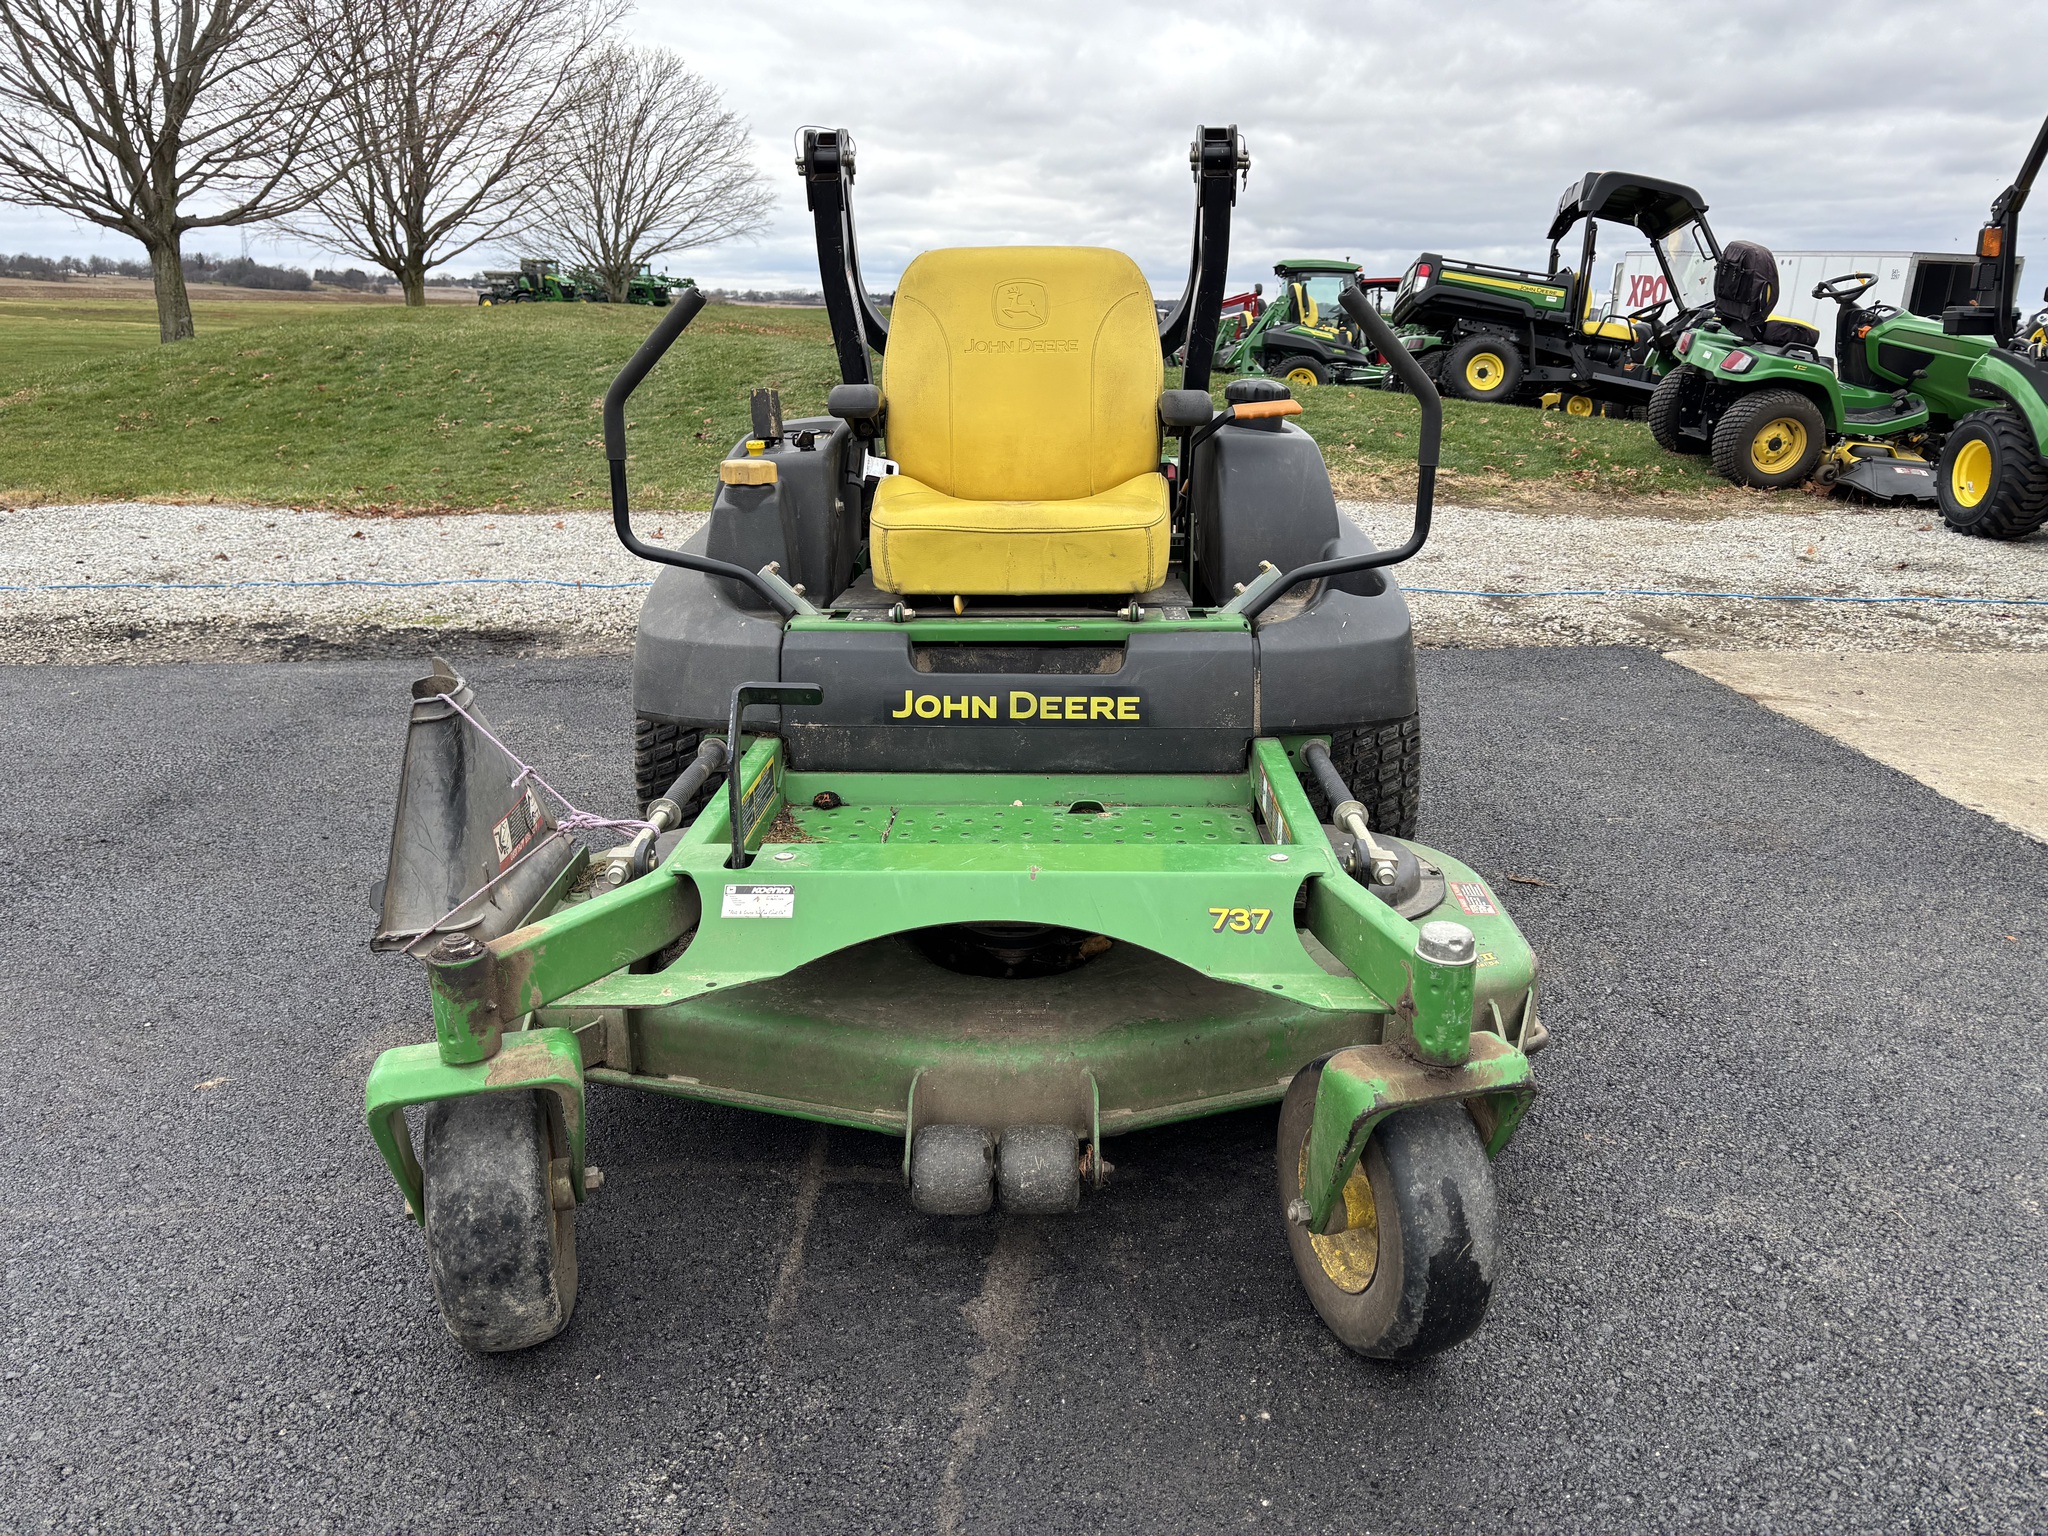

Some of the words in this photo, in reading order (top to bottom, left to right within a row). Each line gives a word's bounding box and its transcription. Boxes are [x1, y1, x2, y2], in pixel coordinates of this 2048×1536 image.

[1626, 274, 1667, 307] XPO
[963, 338, 1014, 353] JOHN
[1018, 337, 1079, 353] DEERE
[892, 690, 997, 719] JOHN
[1009, 691, 1140, 720] DEERE
[1208, 907, 1273, 934] 737
